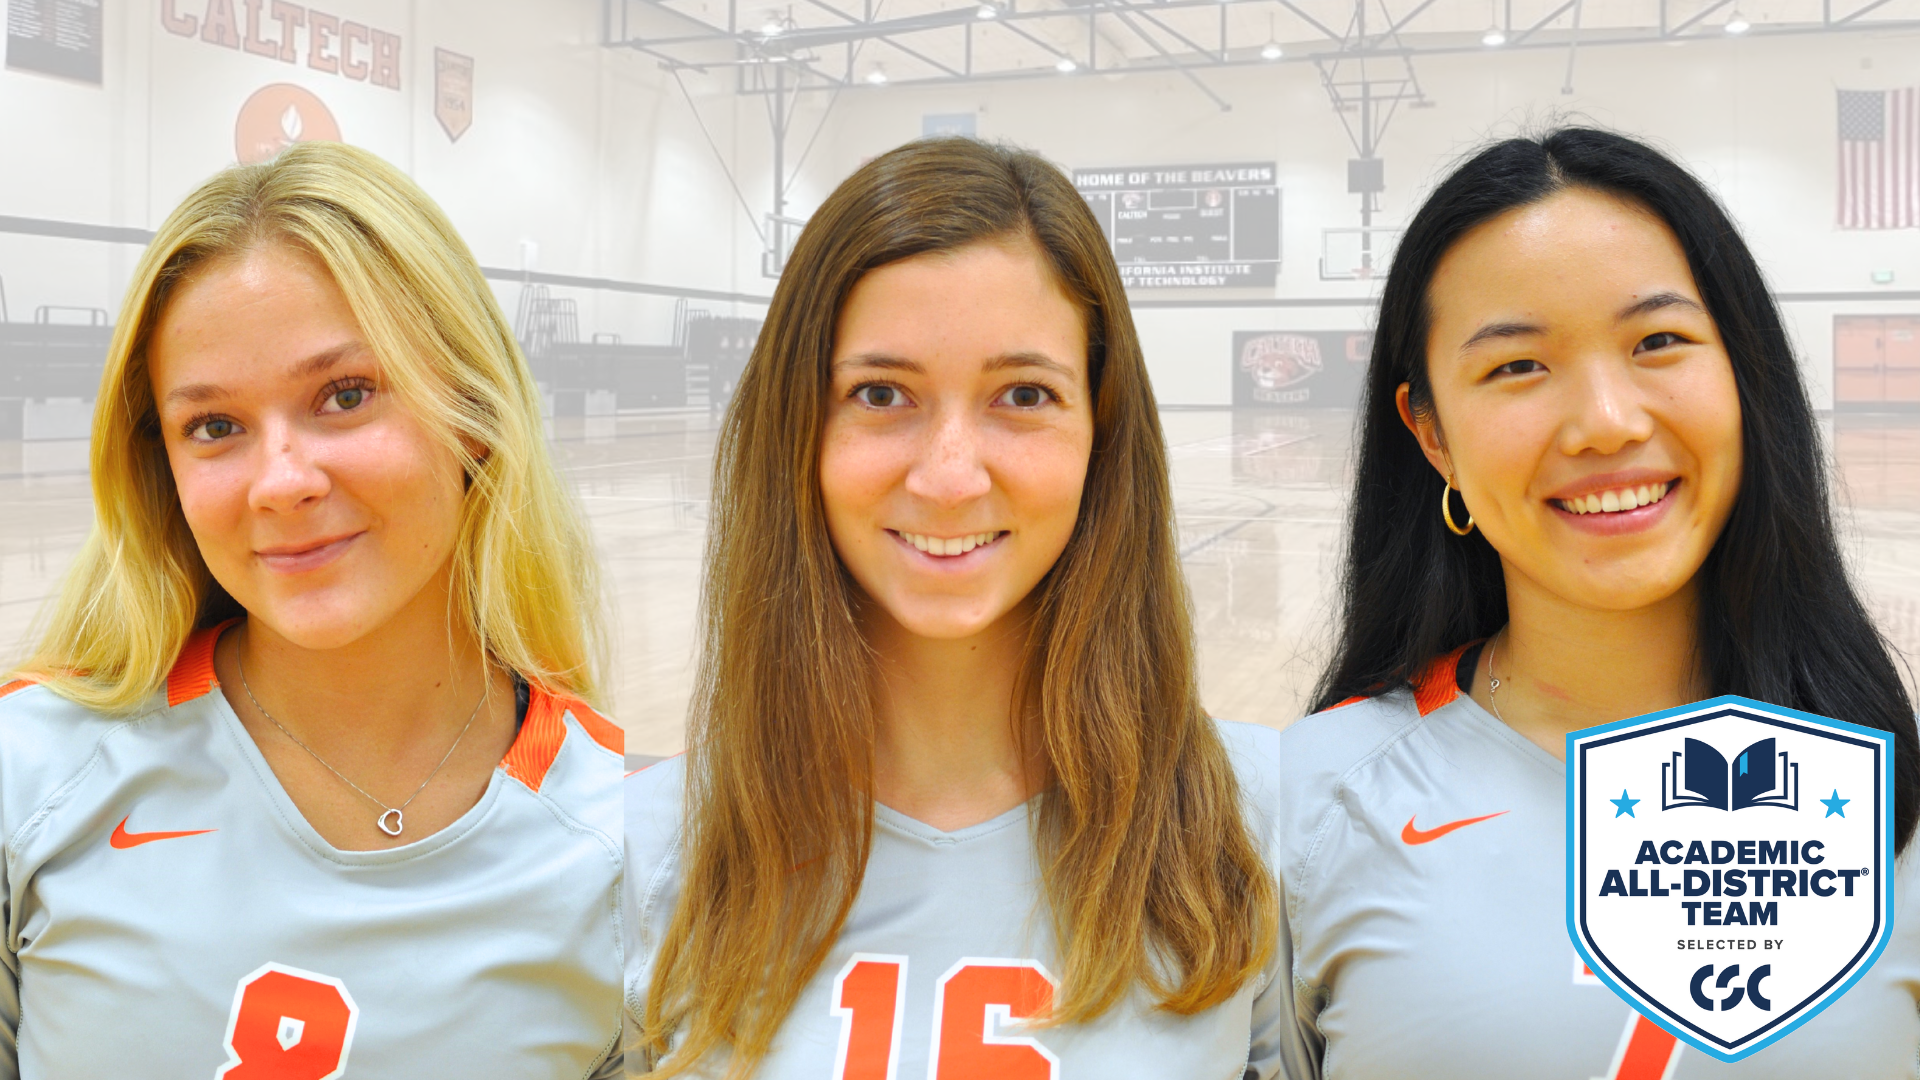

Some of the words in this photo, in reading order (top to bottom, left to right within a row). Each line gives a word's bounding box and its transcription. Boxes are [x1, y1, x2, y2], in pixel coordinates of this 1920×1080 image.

[161, 0, 402, 92] CALTECH
[1076, 173, 1124, 187] HOME
[1128, 172, 1147, 185] OF
[1154, 171, 1188, 184] THE
[1190, 168, 1272, 183] BEAVERS
[1121, 265, 1176, 276] IFORNIA
[1180, 264, 1252, 275] INSTITUTE
[1139, 275, 1227, 287] TECHNOLOGY
[830, 952, 1061, 1080] 16
